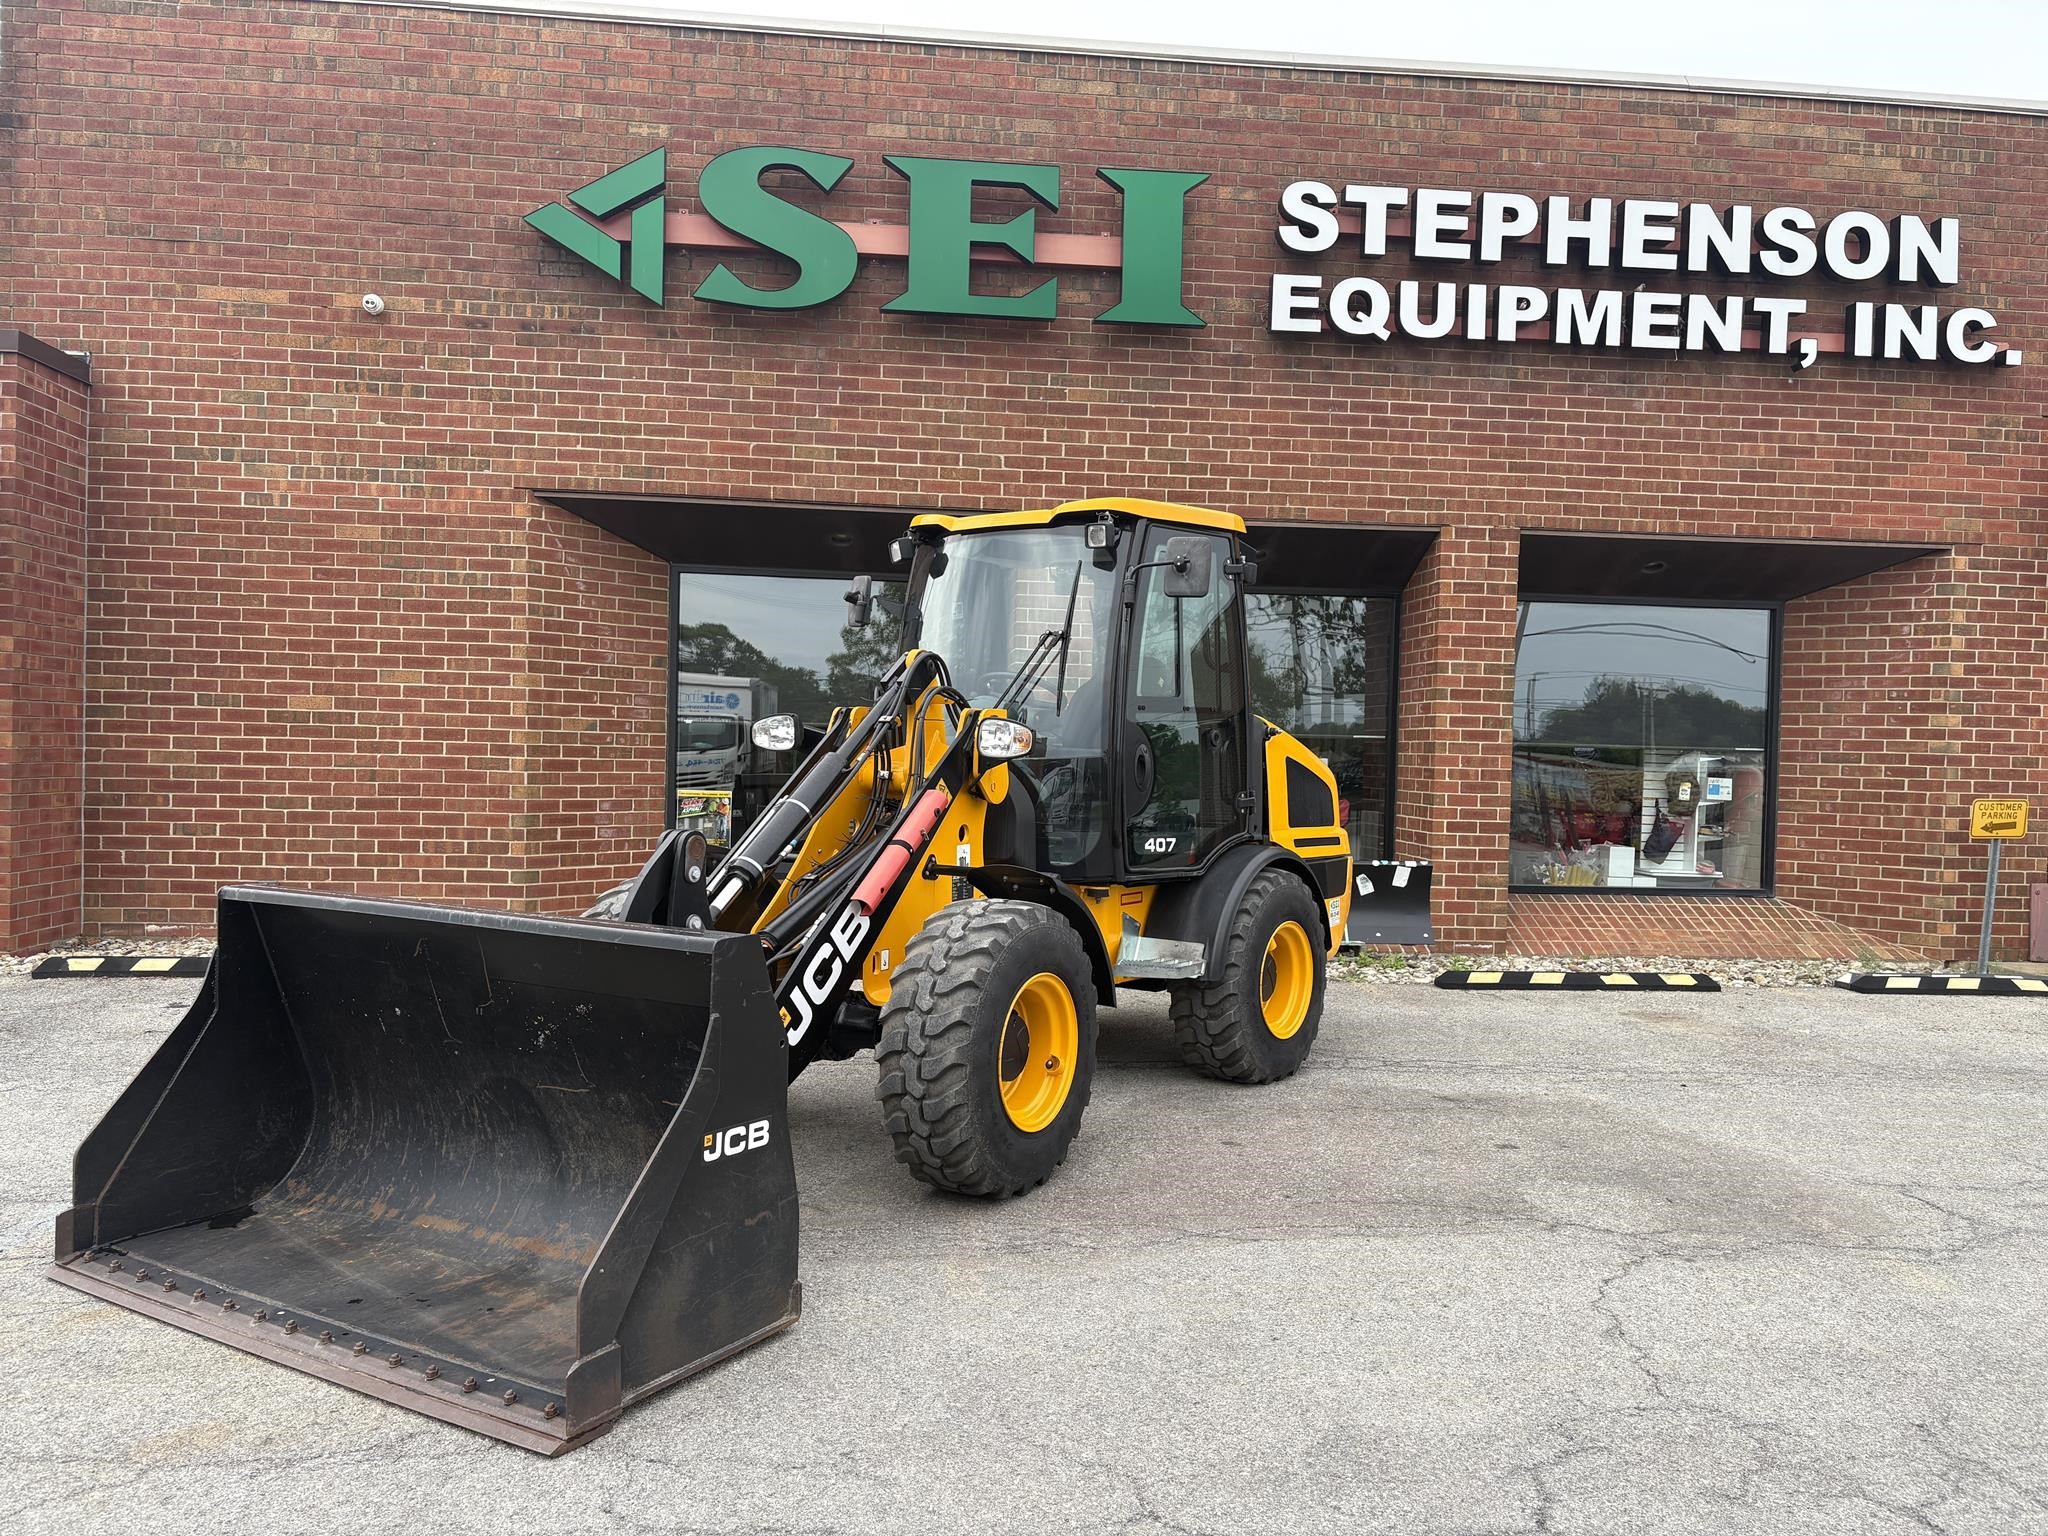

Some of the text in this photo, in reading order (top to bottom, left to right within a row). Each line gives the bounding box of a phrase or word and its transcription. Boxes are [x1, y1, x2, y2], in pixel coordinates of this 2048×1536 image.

[690, 145, 1210, 328] SEI
[1278, 180, 1961, 285] STEPHENSON
[1270, 274, 2022, 369] EQUIPMENT, INC.
[1978, 803, 2022, 811] CUSTOMER
[1981, 812, 2018, 820] PARKING
[1144, 837, 1176, 853] 407
[786, 899, 871, 1047] JCB
[703, 1119, 770, 1162] JCB
